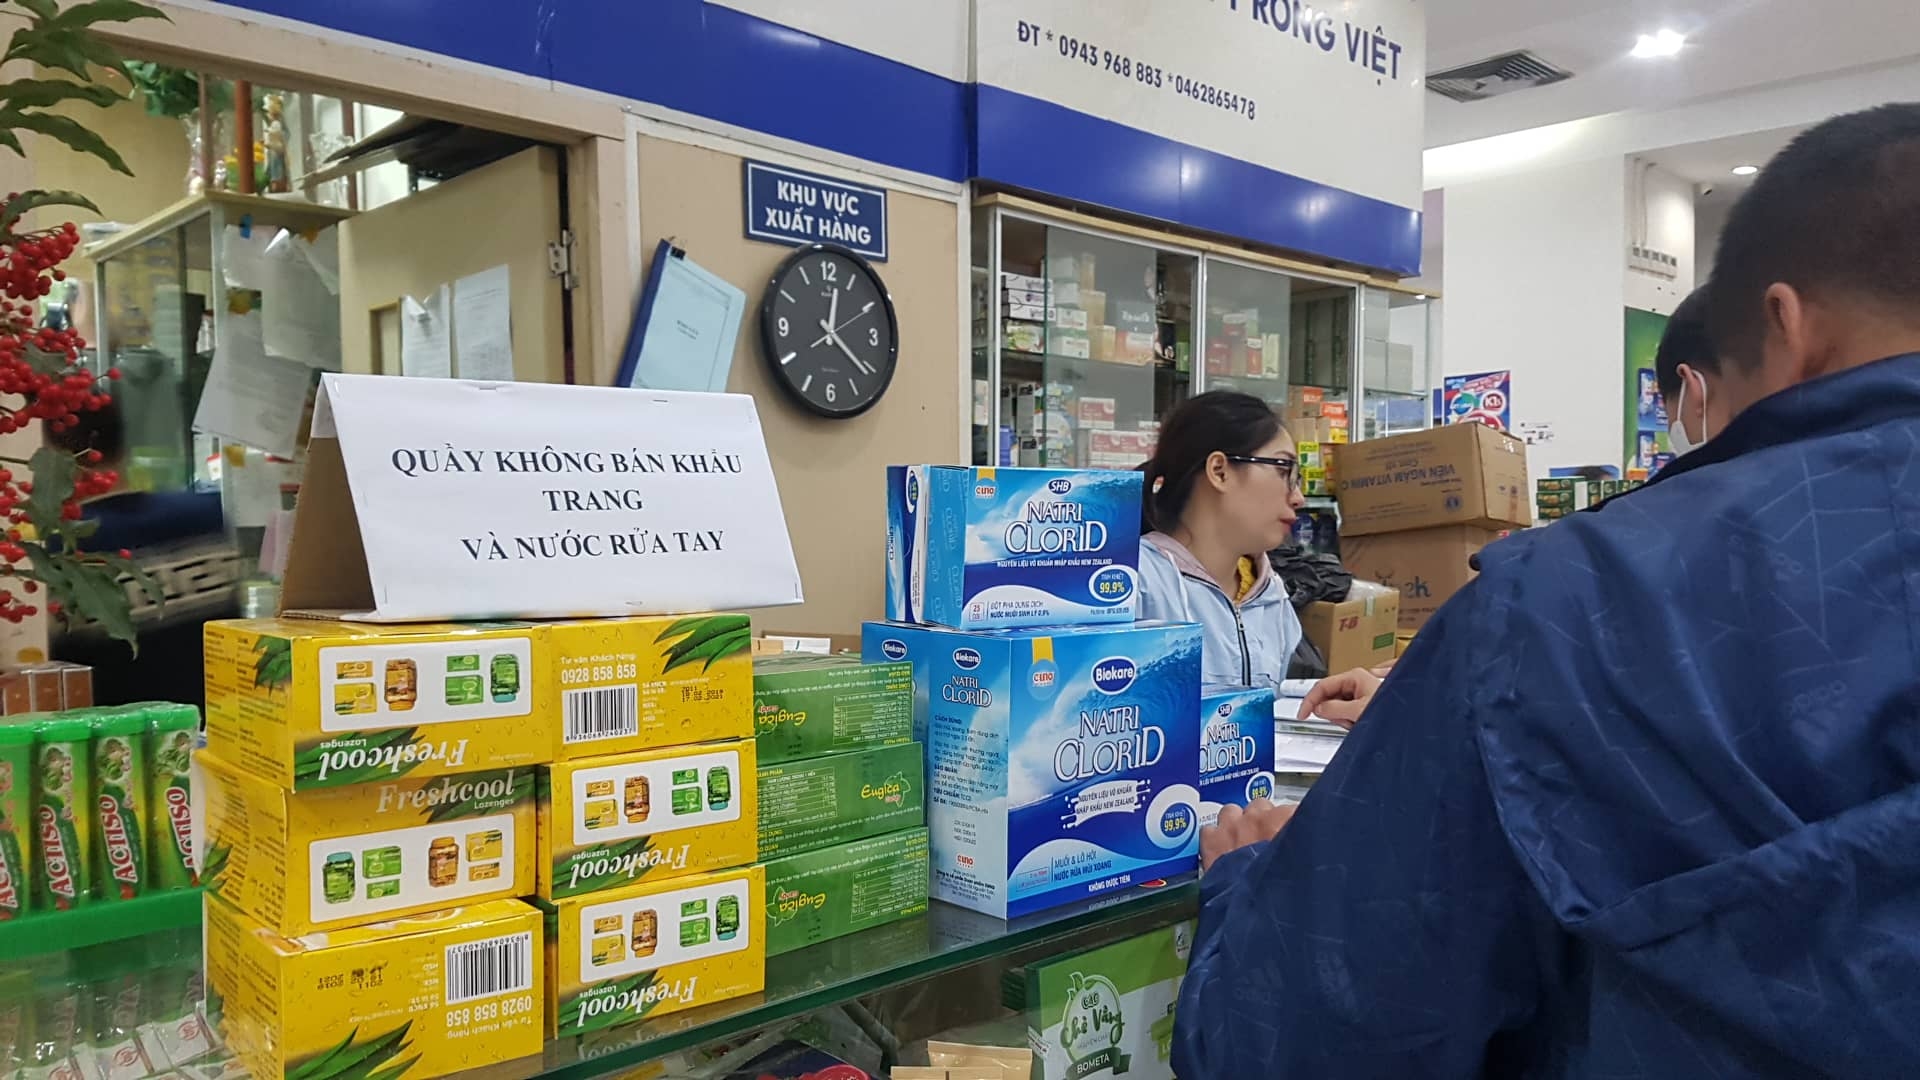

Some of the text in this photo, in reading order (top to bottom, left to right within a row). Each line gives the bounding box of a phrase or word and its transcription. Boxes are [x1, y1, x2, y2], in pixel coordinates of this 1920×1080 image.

[1018, 20, 1039, 46] ĐT
[1059, 35, 1098, 66] 0943
[1104, 50, 1130, 77] 968
[1136, 62, 1162, 88] 883
[1345, 26, 1401, 86] VIỆT
[777, 180, 859, 216] KHU VỰC
[765, 206, 872, 244] XUẤT HÀNG
[820, 260, 837, 282] 12
[778, 317, 789, 337] 9
[869, 328, 879, 346] 3
[825, 383, 836, 402] 6
[391, 442, 742, 478] QUẦY KHÔNG BÁN KHẨU
[1050, 480, 1070, 492] SHB
[542, 488, 643, 512] TRANG
[1027, 501, 1082, 523] NATRI
[460, 527, 724, 561] VÀ NƯỚC RỬA TAY
[1005, 520, 1108, 554] CLORID
[955, 652, 979, 663] Biokare
[561, 663, 637, 684] 0928 858 858
[952, 675, 978, 689] NATRI
[1095, 665, 1134, 682] Biokare
[942, 684, 992, 707] CLORID
[758, 709, 807, 727] Eugica
[1080, 706, 1139, 738] NATRI
[320, 738, 367, 750] Lozenges
[1207, 722, 1240, 745] NATRI
[318, 740, 469, 781] Freshcool
[1054, 725, 1165, 781] CLORID
[376, 770, 515, 813] Freshcool
[861, 783, 901, 801] Eugica
[474, 798, 514, 809] Lozenges
[99, 794, 139, 883] ACTISO
[38, 803, 75, 897] ACTISO
[572, 849, 610, 861] Lozenges
[569, 844, 690, 889] Freshcool
[779, 892, 826, 913] Eugica
[576, 976, 698, 1027] Freshcool
[579, 985, 617, 998] Lozenges
[475, 1003, 497, 1019] 858
[501, 995, 532, 1016] 0928
[446, 1008, 470, 1027] 858
[1077, 1053, 1110, 1074] BOMETA
